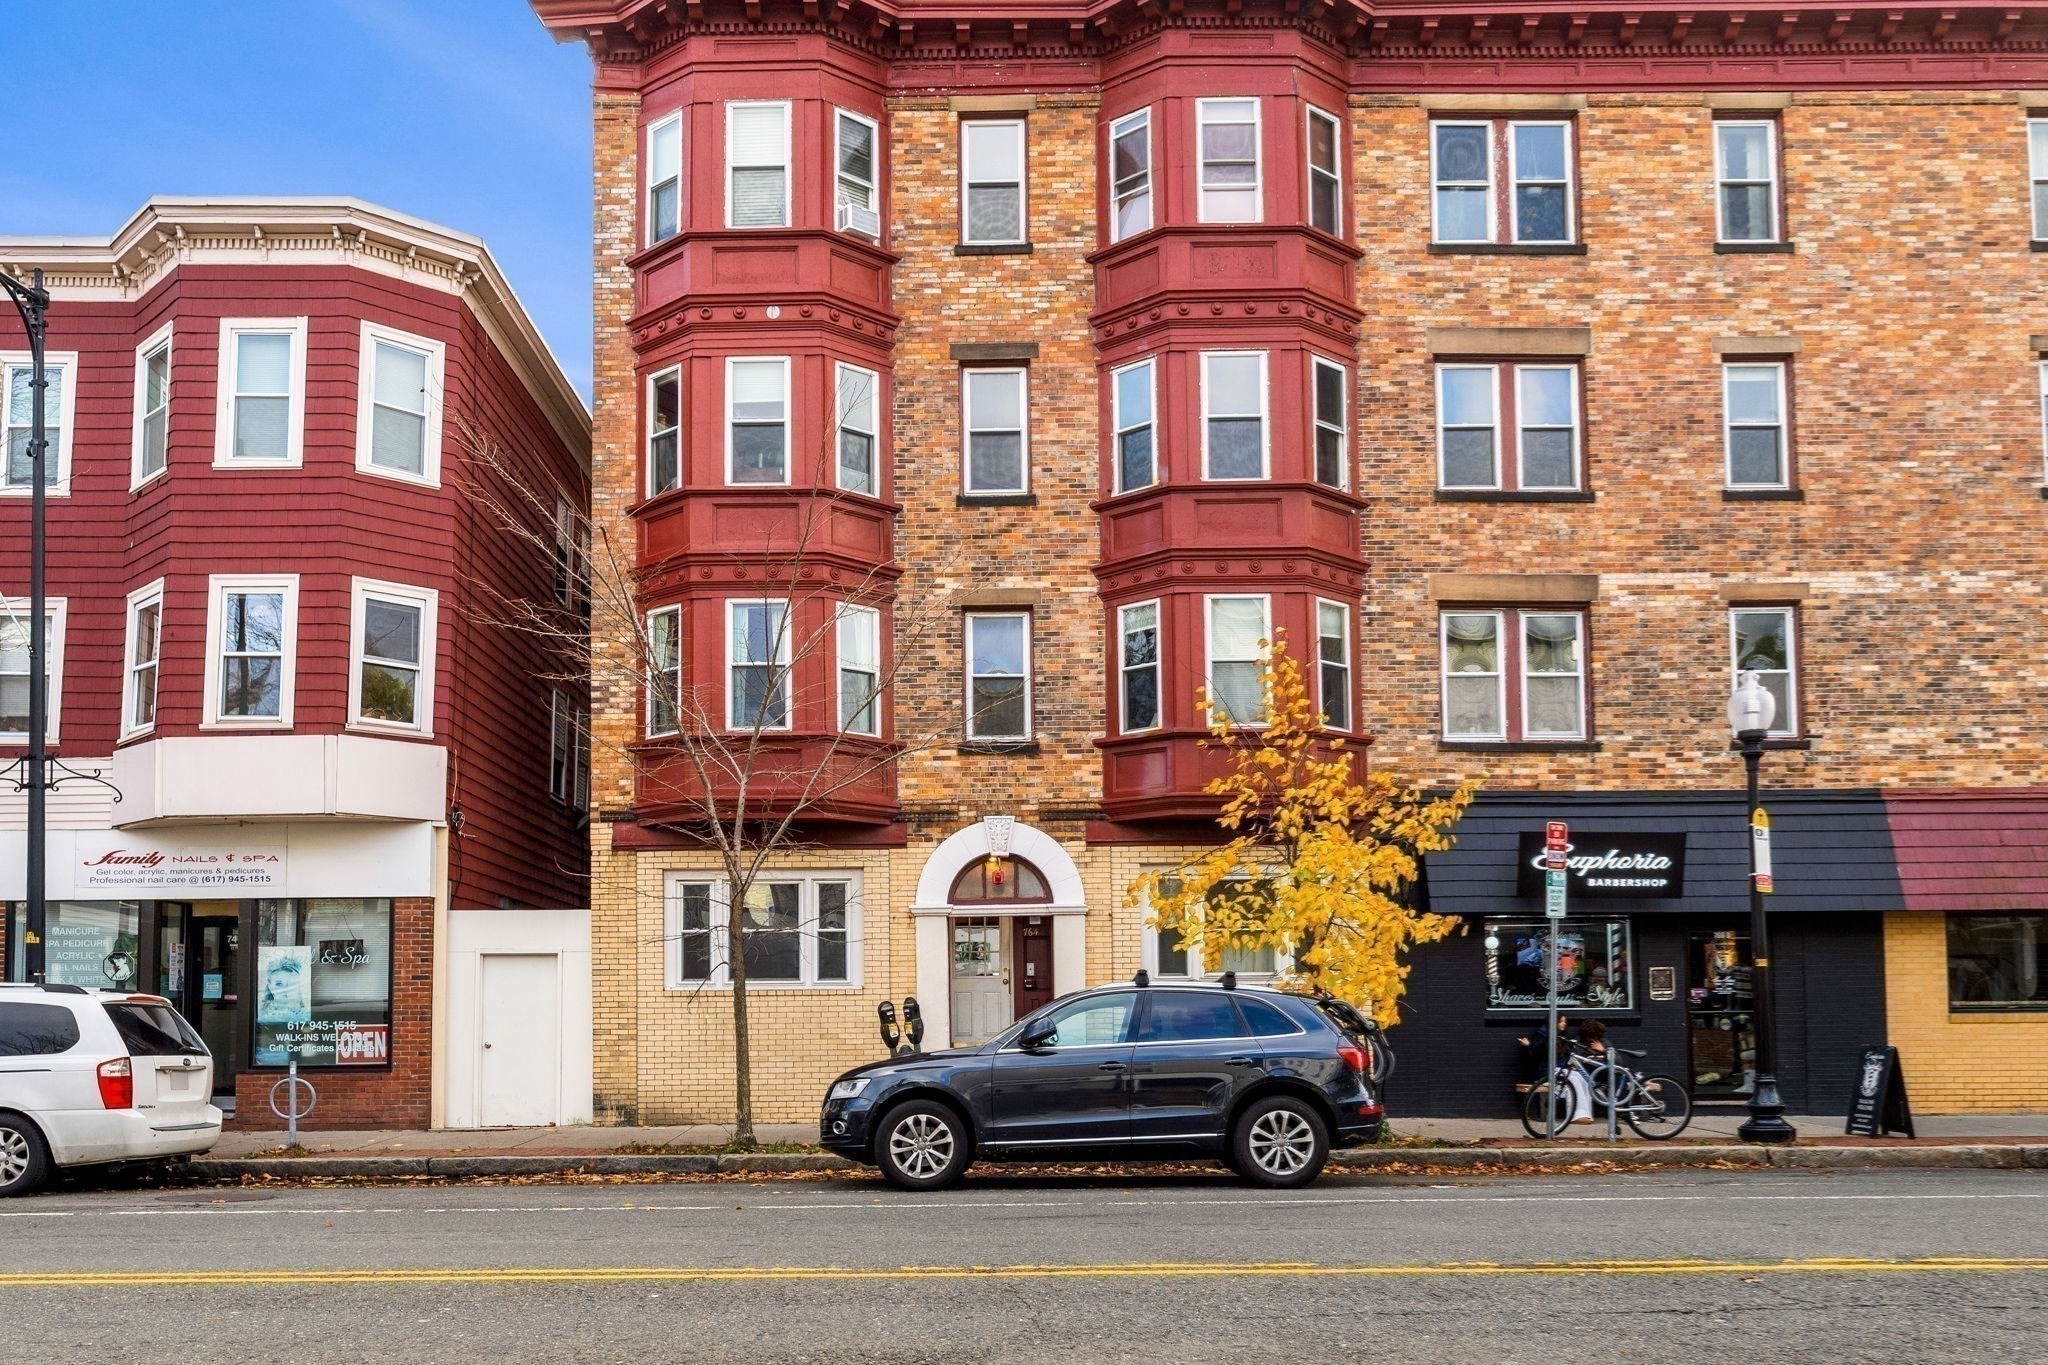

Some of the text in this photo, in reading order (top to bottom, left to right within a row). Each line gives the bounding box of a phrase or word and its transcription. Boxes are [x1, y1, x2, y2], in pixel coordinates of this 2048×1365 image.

[172, 855, 218, 863] NAILS
[242, 855, 279, 863] SPA
[1530, 843, 1672, 877] Euphoria
[113, 868, 136, 876] color,
[138, 868, 167, 876] acrylic,
[224, 867, 265, 875] pedicures
[89, 876, 145, 884] Professional
[147, 876, 165, 884] nail
[188, 876, 200, 885] @
[201, 875, 226, 884] (617)
[228, 875, 271, 883] 945-1515
[1587, 878, 1668, 887] BARBERSHOP
[51, 927, 100, 936] MANICURE
[1023, 928, 1039, 937] 764
[45, 939, 108, 948] SPA PEDICURE
[55, 952, 95, 960] ACRYLIC
[321, 949, 338, 964] &
[340, 946, 370, 969] Spa
[72, 963, 99, 972] NAILS
[78, 976, 106, 984] WHITE
[1586, 985, 1625, 1008] Style
[287, 1020, 357, 1031] 617 945-1515
[275, 1033, 320, 1042] WALK-INS
[269, 1043, 285, 1052] Gift
[286, 1043, 335, 1052] Certificates
[340, 1031, 386, 1059] OPEN
